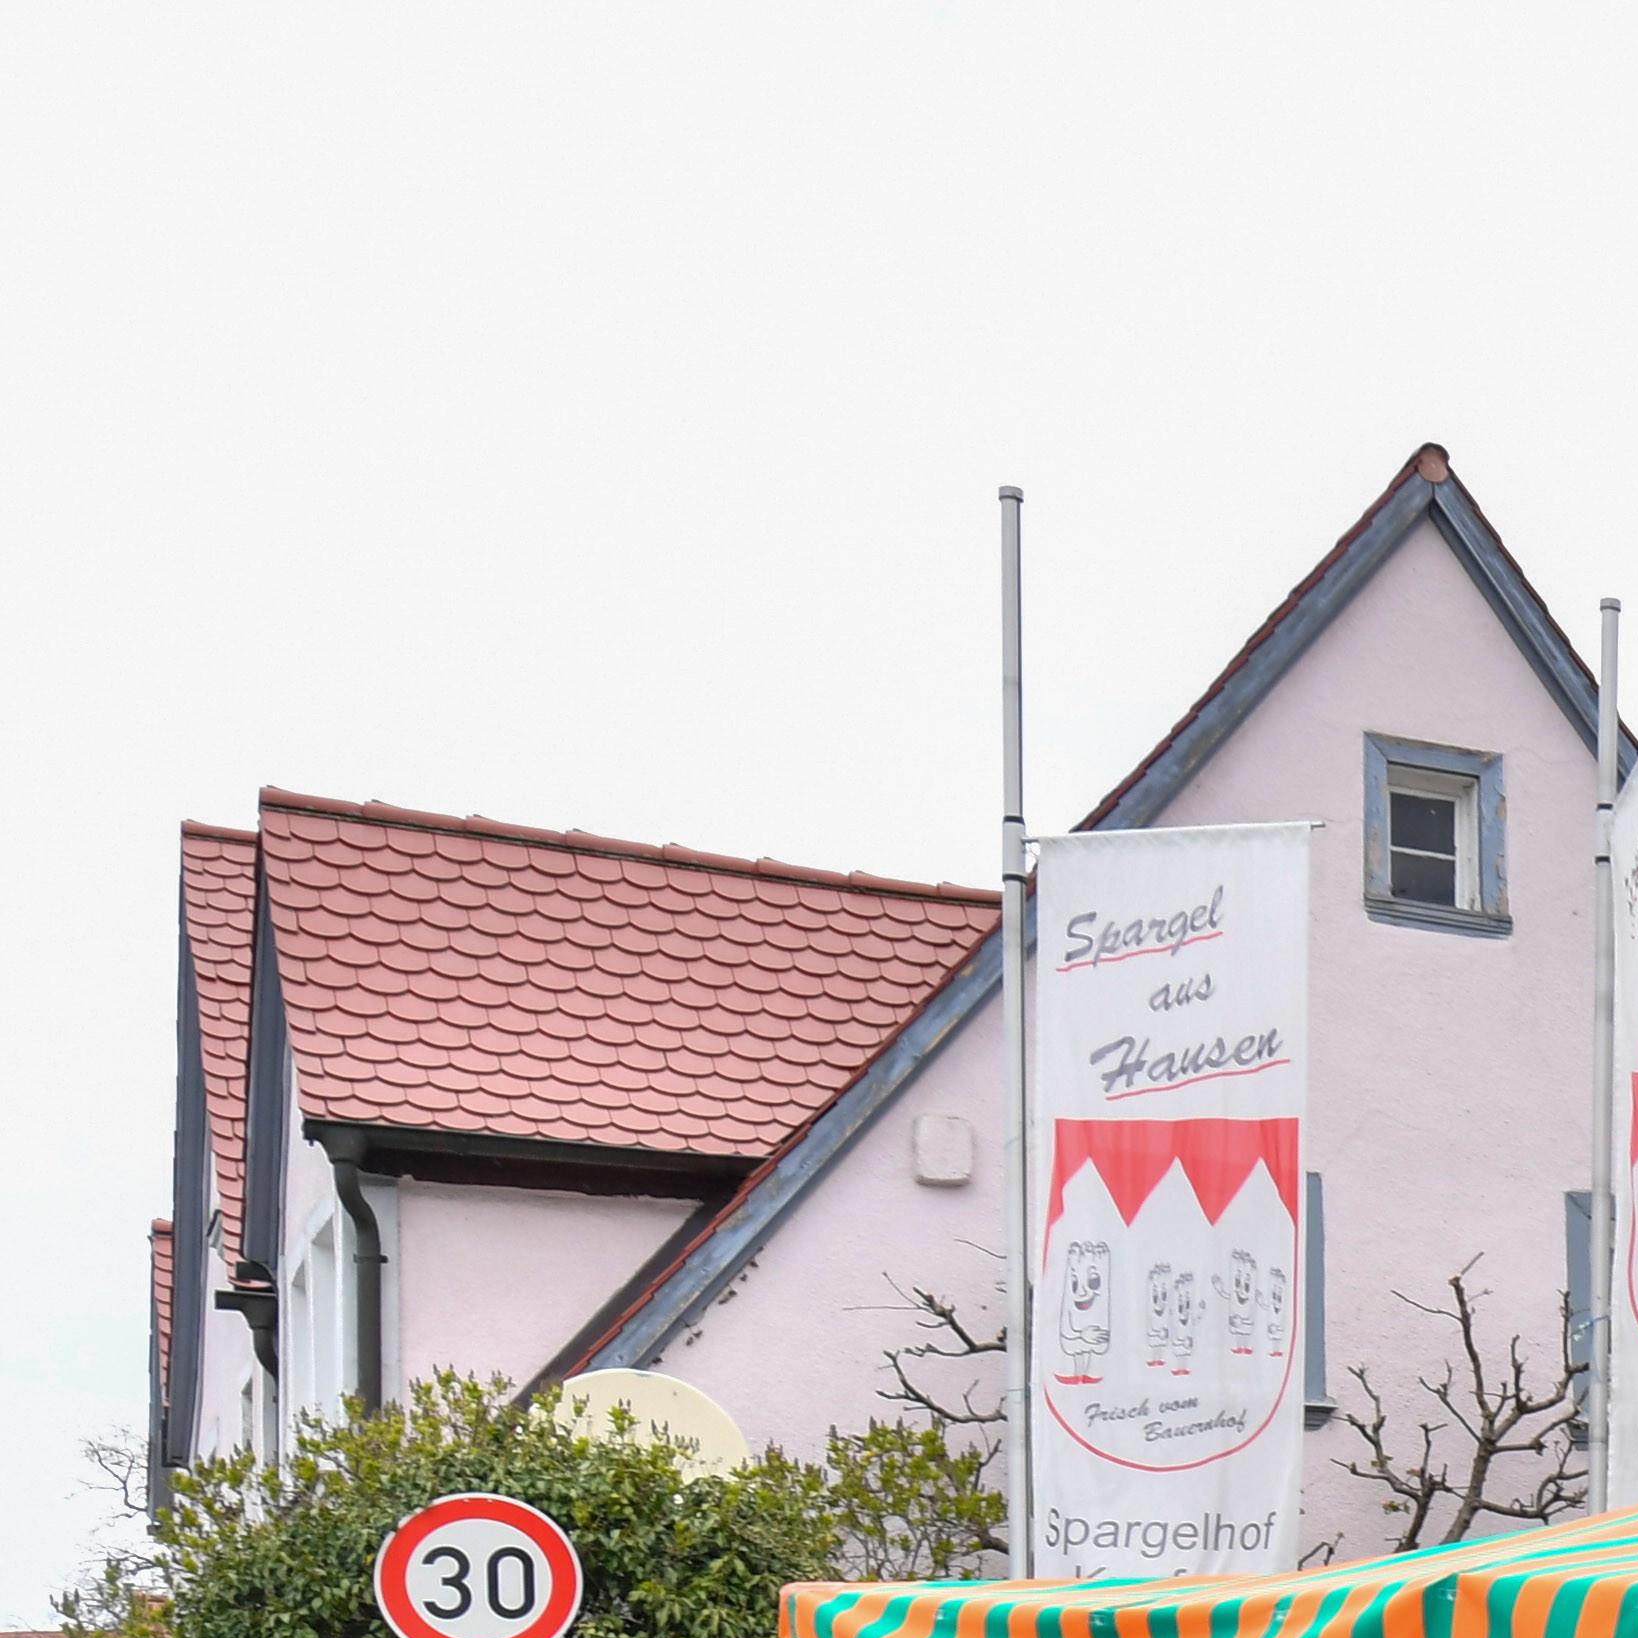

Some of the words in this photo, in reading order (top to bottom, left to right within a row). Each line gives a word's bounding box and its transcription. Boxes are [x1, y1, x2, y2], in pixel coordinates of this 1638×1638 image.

[1064, 885, 1224, 968] Spargel
[1149, 973, 1215, 1012] aus
[1089, 1028, 1284, 1093] Hausen
[1083, 1398, 1150, 1428] Frisch
[1158, 1396, 1199, 1414] vom
[1142, 1409, 1248, 1442] Bauernhof
[1045, 1507, 1278, 1559] Spargelhof
[421, 1546, 536, 1621] 30
